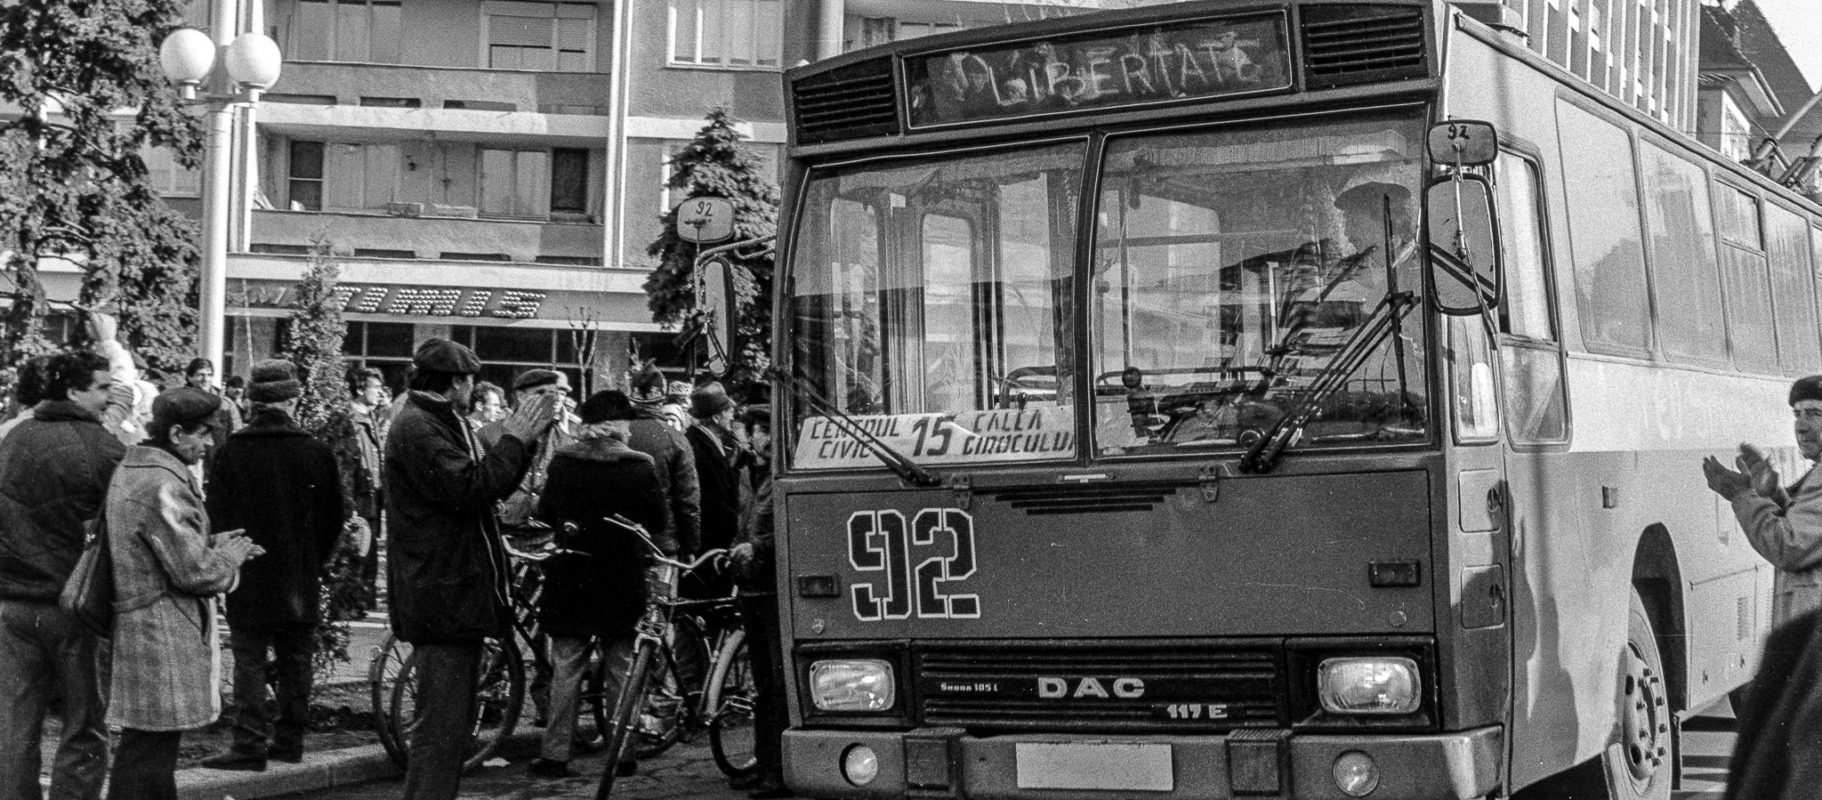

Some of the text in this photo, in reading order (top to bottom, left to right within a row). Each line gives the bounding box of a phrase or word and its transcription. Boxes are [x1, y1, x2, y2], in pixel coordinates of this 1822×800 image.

[1447, 122, 1471, 140] 92
[695, 200, 714, 217] 92
[911, 414, 957, 457] 15
[818, 439, 876, 460] CIVIC
[847, 507, 981, 622] 92
[1037, 677, 1145, 698] DAC
[1166, 703, 1228, 719] 117 E
